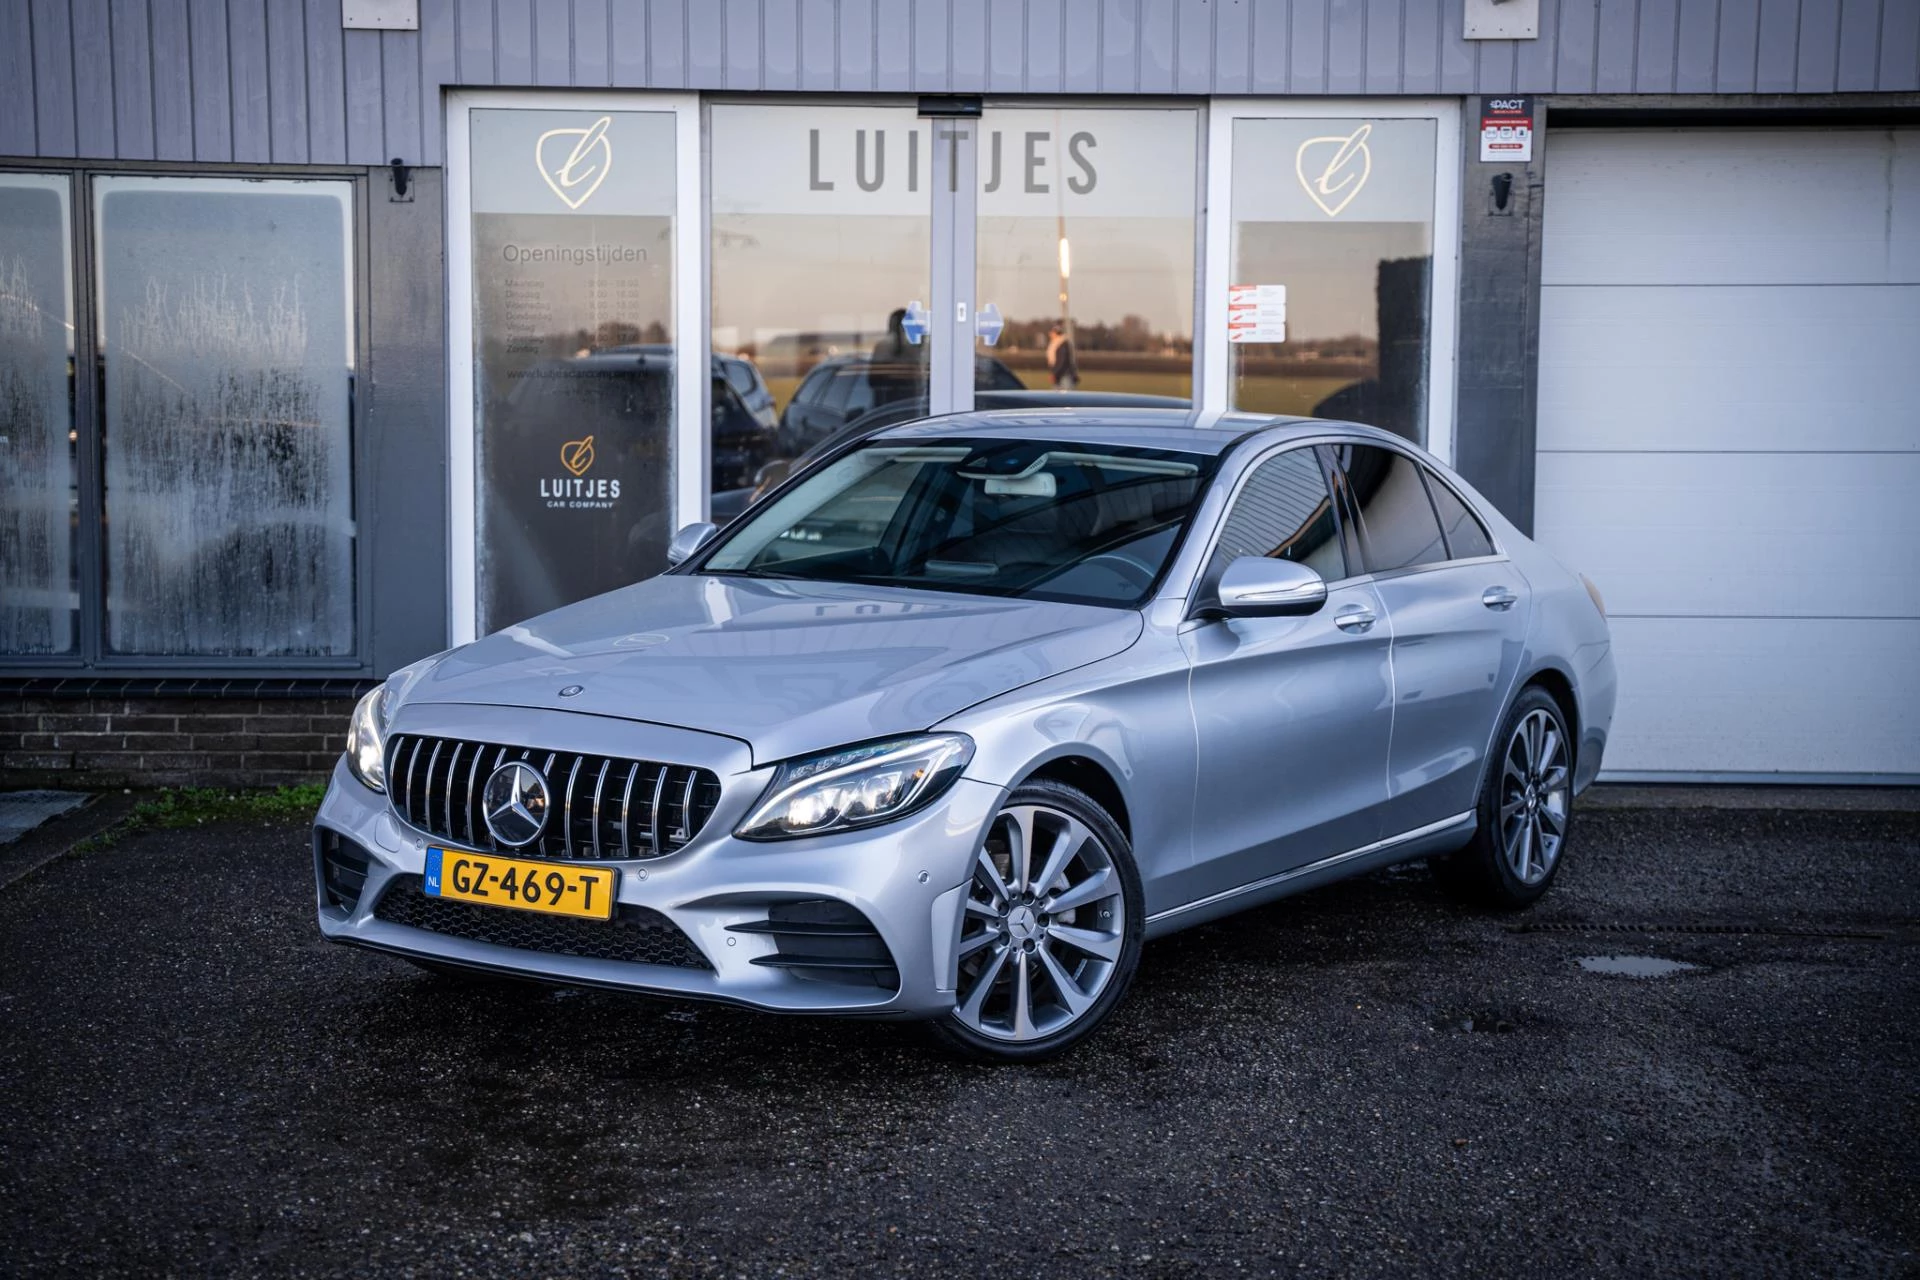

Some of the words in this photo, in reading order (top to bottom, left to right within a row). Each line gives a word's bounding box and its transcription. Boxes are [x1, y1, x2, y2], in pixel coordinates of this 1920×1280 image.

[809, 128, 1098, 195] LUITJES
[503, 244, 648, 266] Openingstijden
[540, 478, 621, 498] LUITJES
[427, 876, 440, 888] NL
[452, 859, 600, 910] GZ-469-T
